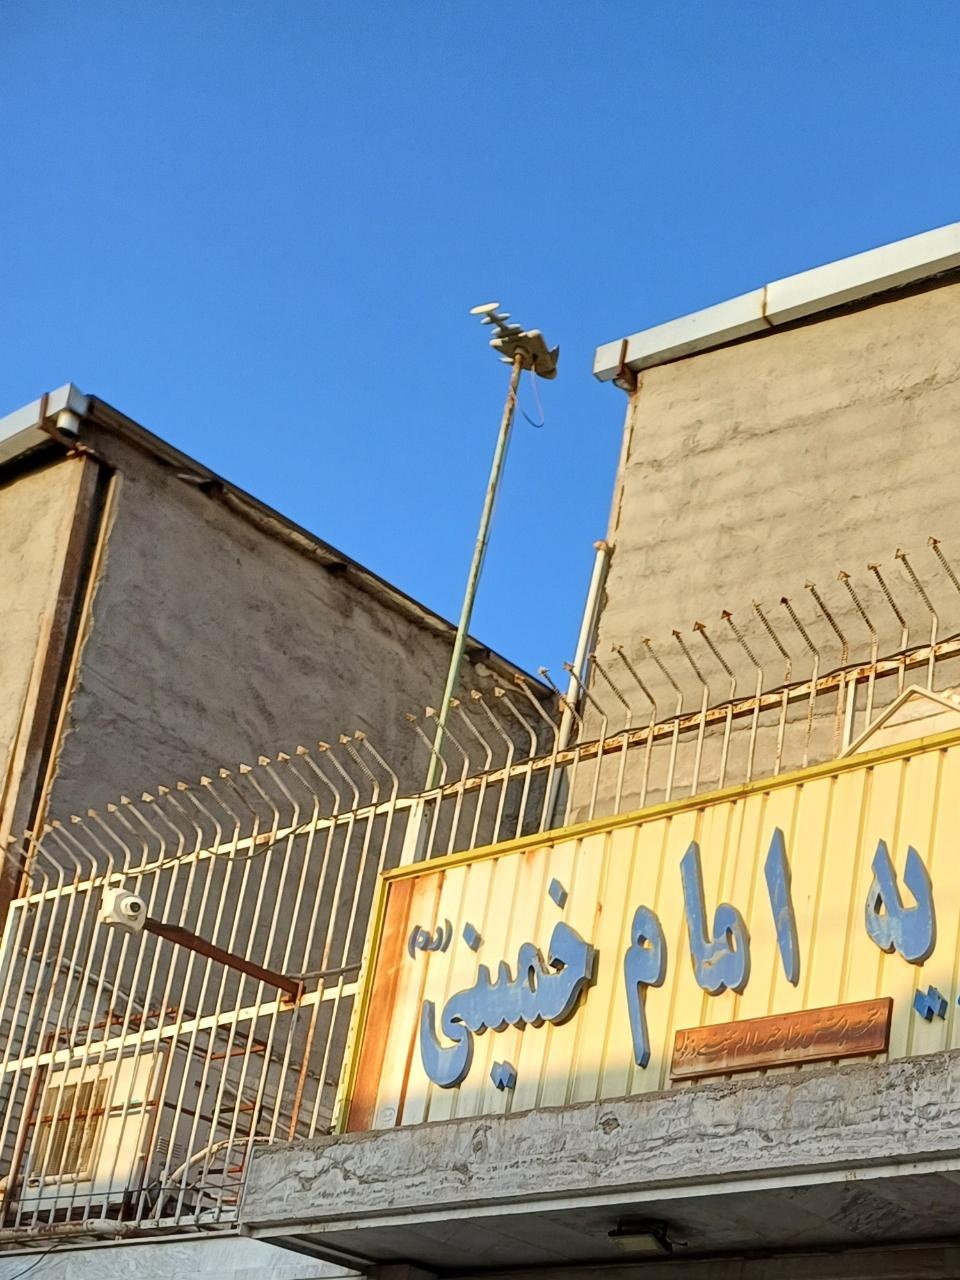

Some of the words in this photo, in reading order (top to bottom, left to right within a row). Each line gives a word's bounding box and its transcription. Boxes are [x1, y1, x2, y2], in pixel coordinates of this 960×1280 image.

[408, 918, 453, 960] (ره)
[420, 876, 599, 1091] خمینی
[623, 826, 800, 1070] امام
